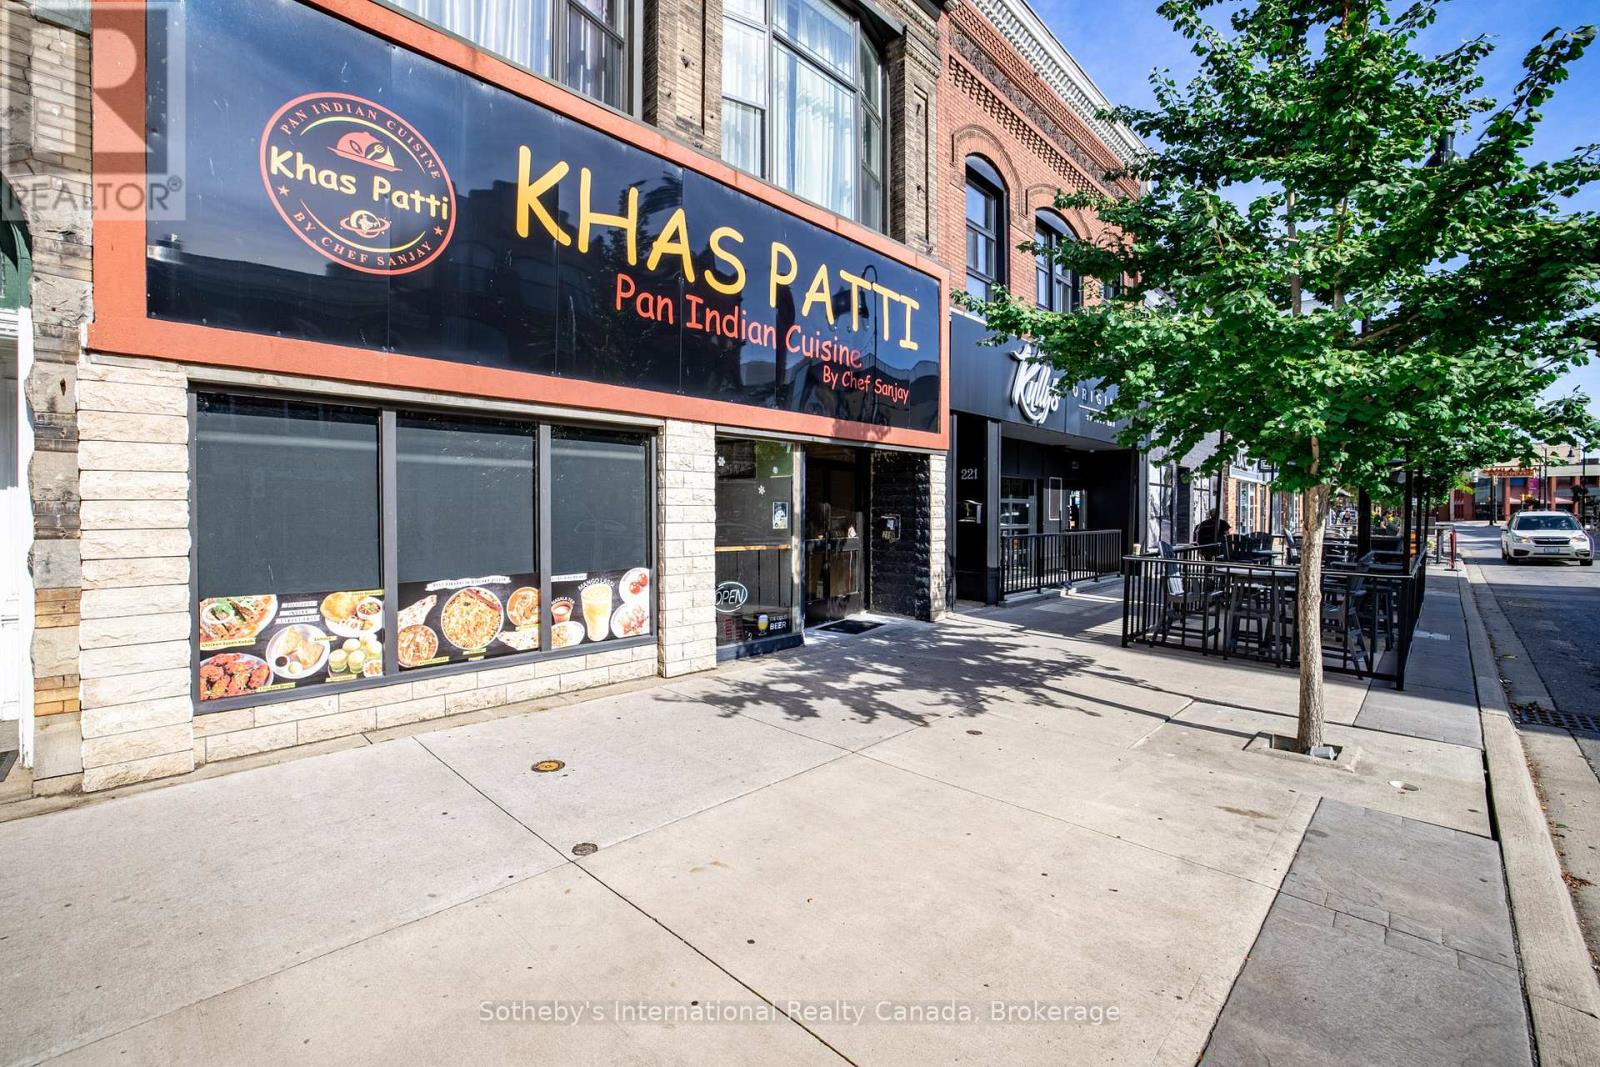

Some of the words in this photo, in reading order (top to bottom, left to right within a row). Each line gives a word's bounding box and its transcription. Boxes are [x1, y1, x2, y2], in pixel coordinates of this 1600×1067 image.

[280, 109, 308, 136] PAN
[312, 102, 377, 120] INDIAN
[387, 120, 440, 180] CUISINE
[270, 145, 357, 195] Khas
[372, 175, 449, 221] Patti
[293, 211, 316, 232] BY
[321, 236, 369, 262] CHEF
[376, 240, 432, 267] SANJAY
[516, 145, 747, 295] KHAS
[769, 241, 920, 351] PATTI
[615, 273, 674, 325] Pan
[685, 294, 777, 350] Indian
[785, 325, 862, 369] Cuisine
[823, 365, 838, 390] By
[841, 371, 871, 393] Chef
[874, 379, 909, 405] Sanjay
[961, 468, 978, 480] 221
[578, 577, 600, 592] MANGO
[715, 589, 744, 605] OPEN
[769, 621, 787, 631] BEER
